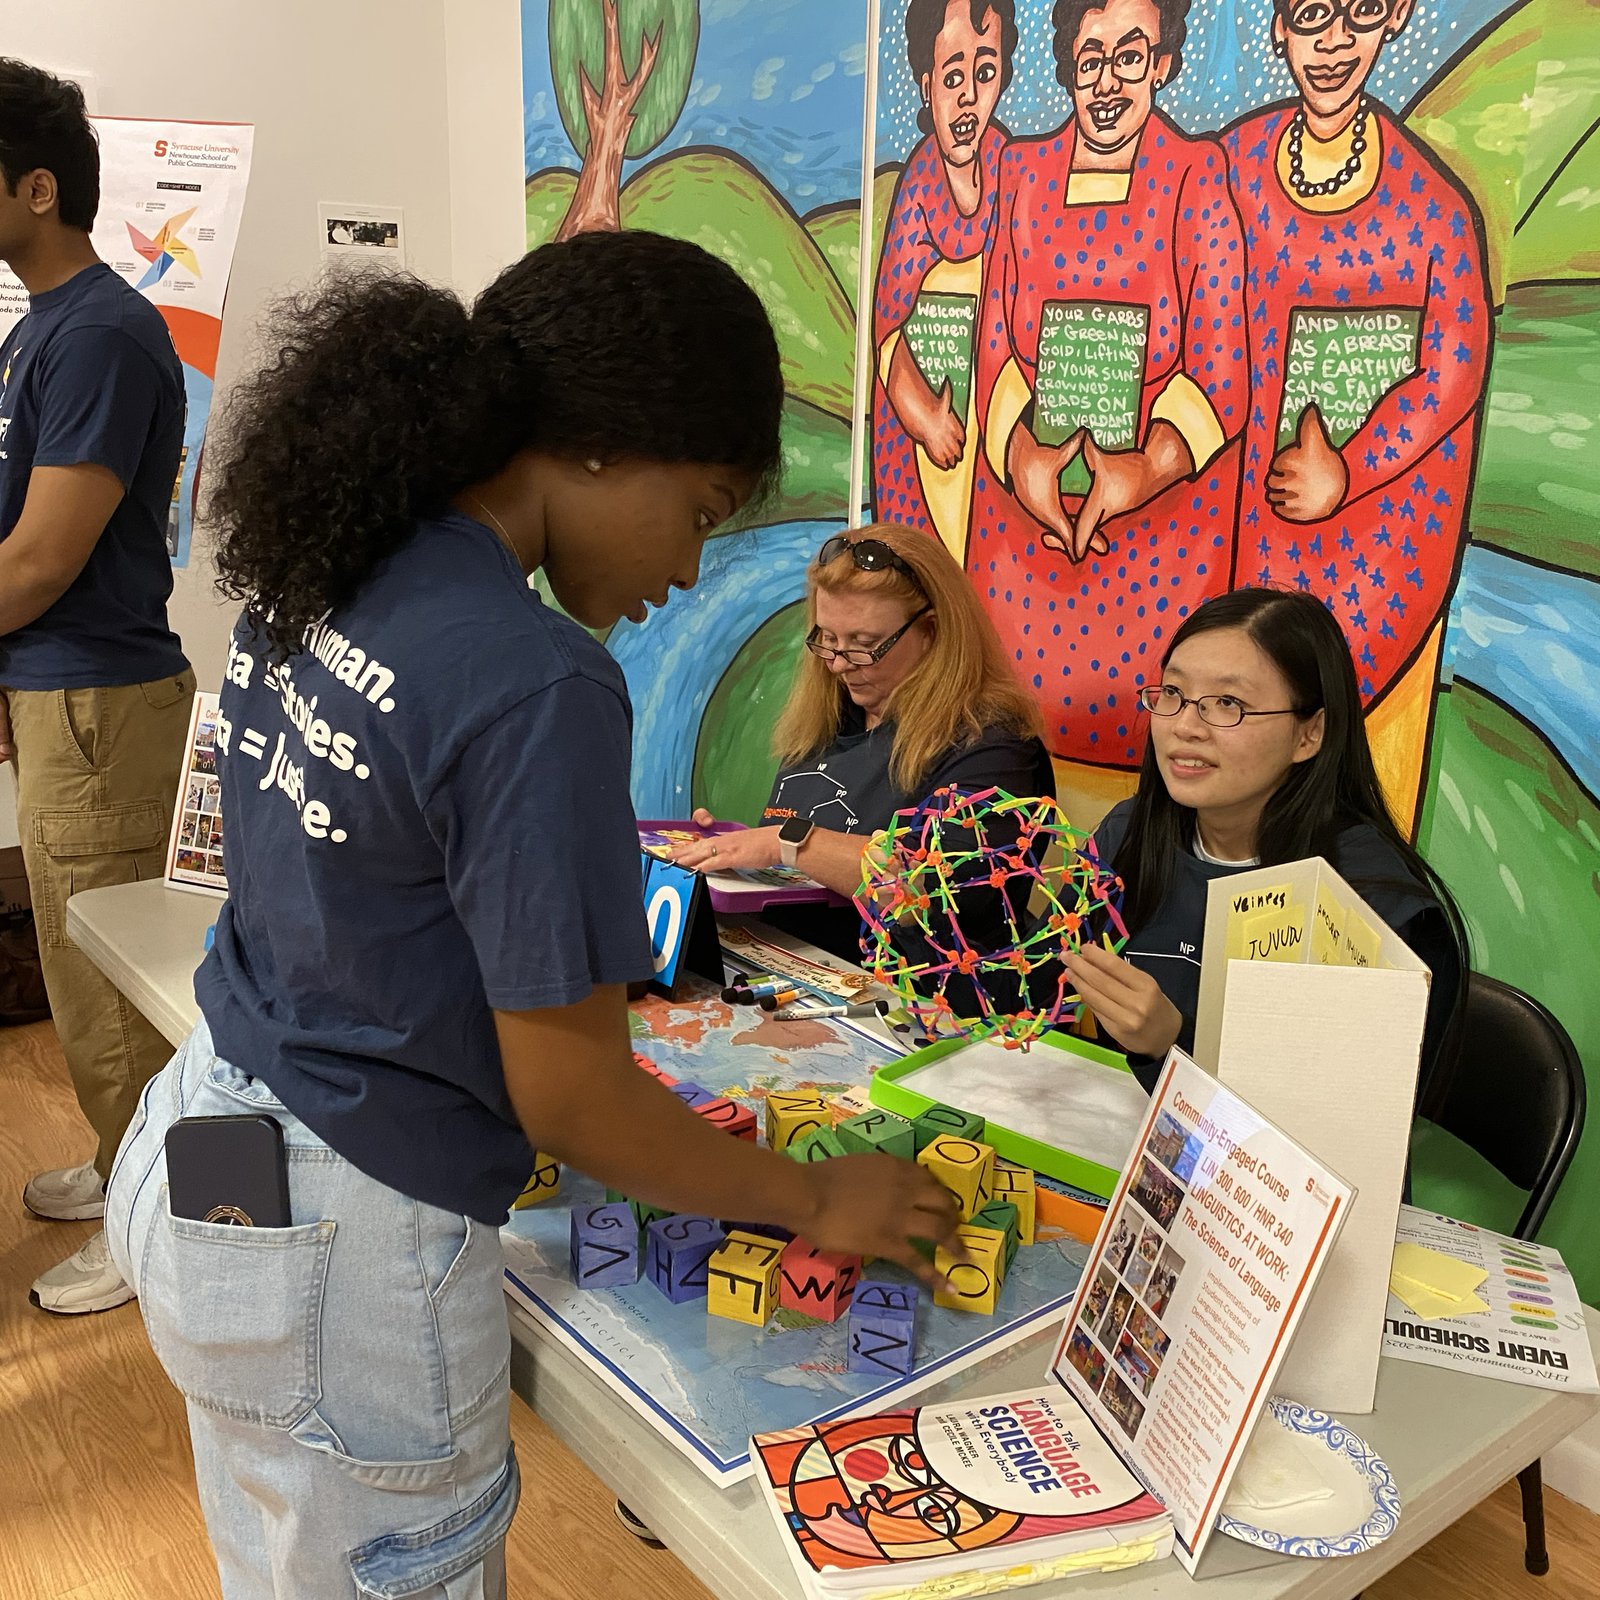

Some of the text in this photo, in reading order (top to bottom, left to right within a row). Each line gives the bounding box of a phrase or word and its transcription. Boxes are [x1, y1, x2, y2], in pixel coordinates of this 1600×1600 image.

[154, 140, 168, 157] S
[168, 159, 236, 170] Public Communications
[169, 151, 200, 160] Newhouse
[201, 153, 220, 161] School
[171, 142, 239, 154] Syracuse University
[1295, 314, 1339, 334] AND
[1290, 338, 1318, 358] AS
[1325, 339, 1341, 356] A
[1039, 359, 1056, 374] UP
[1289, 360, 1315, 376] OF
[1097, 396, 1127, 412] ON
[835, 789, 847, 798] PP
[845, 817, 859, 826] NP
[647, 885, 682, 973] 0
[1180, 941, 1196, 955] NP
[853, 1114, 886, 1134] R
[923, 1109, 967, 1128] D
[935, 1141, 981, 1164] O
[1171, 1092, 1291, 1200] Community-Engaged Course
[1201, 1156, 1293, 1246] LIN 300, 600 / HNR 340
[1306, 1178, 1314, 1191] S
[663, 1218, 713, 1241] S
[1191, 1182, 1290, 1281] LINGUISTICS AT WORK:
[655, 1241, 673, 1295] H
[717, 1238, 780, 1267] E
[1182, 1207, 1281, 1315] The Science of Language
[708, 1267, 763, 1314] F
[781, 1269, 834, 1302] W
[856, 1287, 909, 1311] B
[1207, 1269, 1260, 1326] Implementations of
[1201, 1281, 1245, 1330] Student-Created
[561, 1298, 635, 1359] ANTARCTICA
[1196, 1294, 1250, 1354] Language-Linguistics
[1189, 1327, 1207, 1350] SOURCE
[1206, 1347, 1222, 1367] Spring
[1385, 1339, 1570, 1383] EHN Community Showcase 2025
[1496, 1340, 1569, 1370] EVENT
[1176, 1358, 1202, 1390] Science and
[1181, 1348, 1230, 1406] The MoST (Museum of
[1168, 1378, 1186, 1402] Cultures
[1185, 1400, 1192, 1410] on
[1192, 1407, 1201, 1419] the
[945, 1414, 979, 1459] LAURA WAGNER
[1035, 1397, 1080, 1452] How to Talk
[1156, 1409, 1180, 1441] Scholarship
[1168, 1408, 1187, 1434] Research
[1192, 1437, 1211, 1463] Creative
[942, 1424, 960, 1446] CECILE
[954, 1445, 974, 1469] MCKEE
[965, 1410, 1018, 1484] with Everybody
[979, 1405, 1063, 1494] SCIENCE
[1008, 1399, 1101, 1499] LANGUAGE
[1148, 1429, 1191, 1485] Engaged Community
